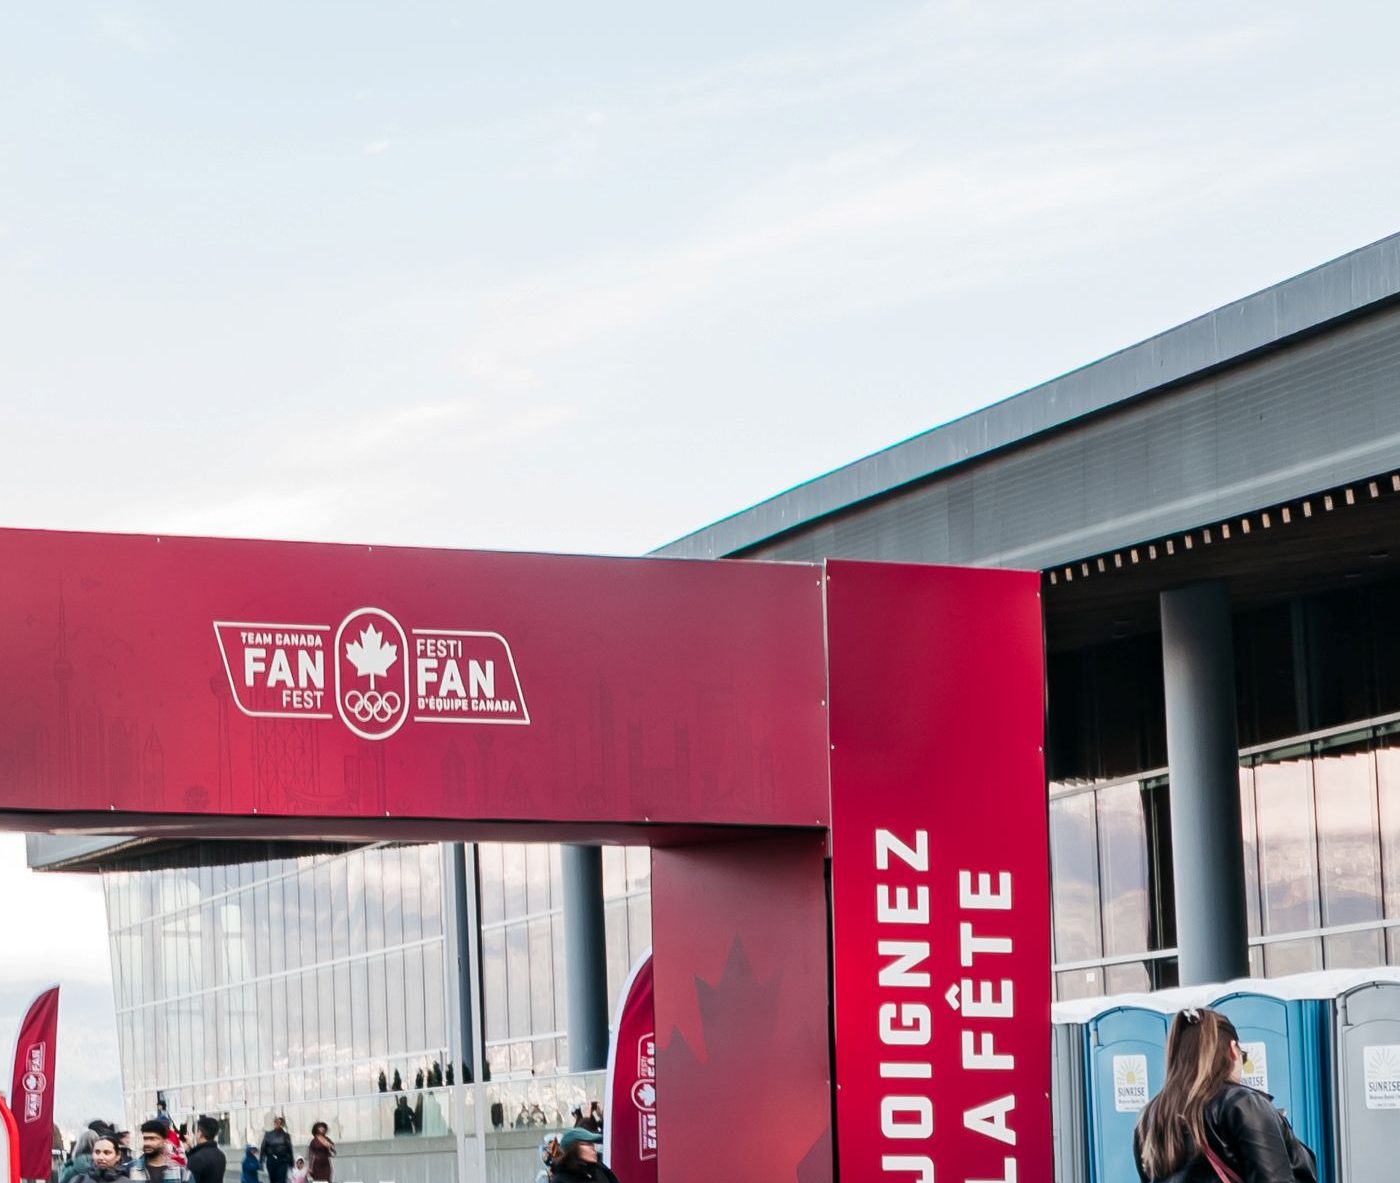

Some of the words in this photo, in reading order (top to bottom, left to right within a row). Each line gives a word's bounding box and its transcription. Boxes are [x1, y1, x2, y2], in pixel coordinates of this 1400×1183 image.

[241, 631, 272, 645] TEAM
[275, 633, 322, 647] CANADA
[416, 638, 462, 658] FESTI
[244, 647, 325, 690] FAN
[416, 658, 495, 699] FAN
[282, 689, 324, 710] FEST
[417, 696, 469, 712] D'ÉQUIPE
[471, 698, 517, 712] CANADA
[944, 868, 1015, 1071] FÊTE
[1118, 1086, 1145, 1097] SUNRISE
[1368, 1080, 1400, 1092] SUNRISE
